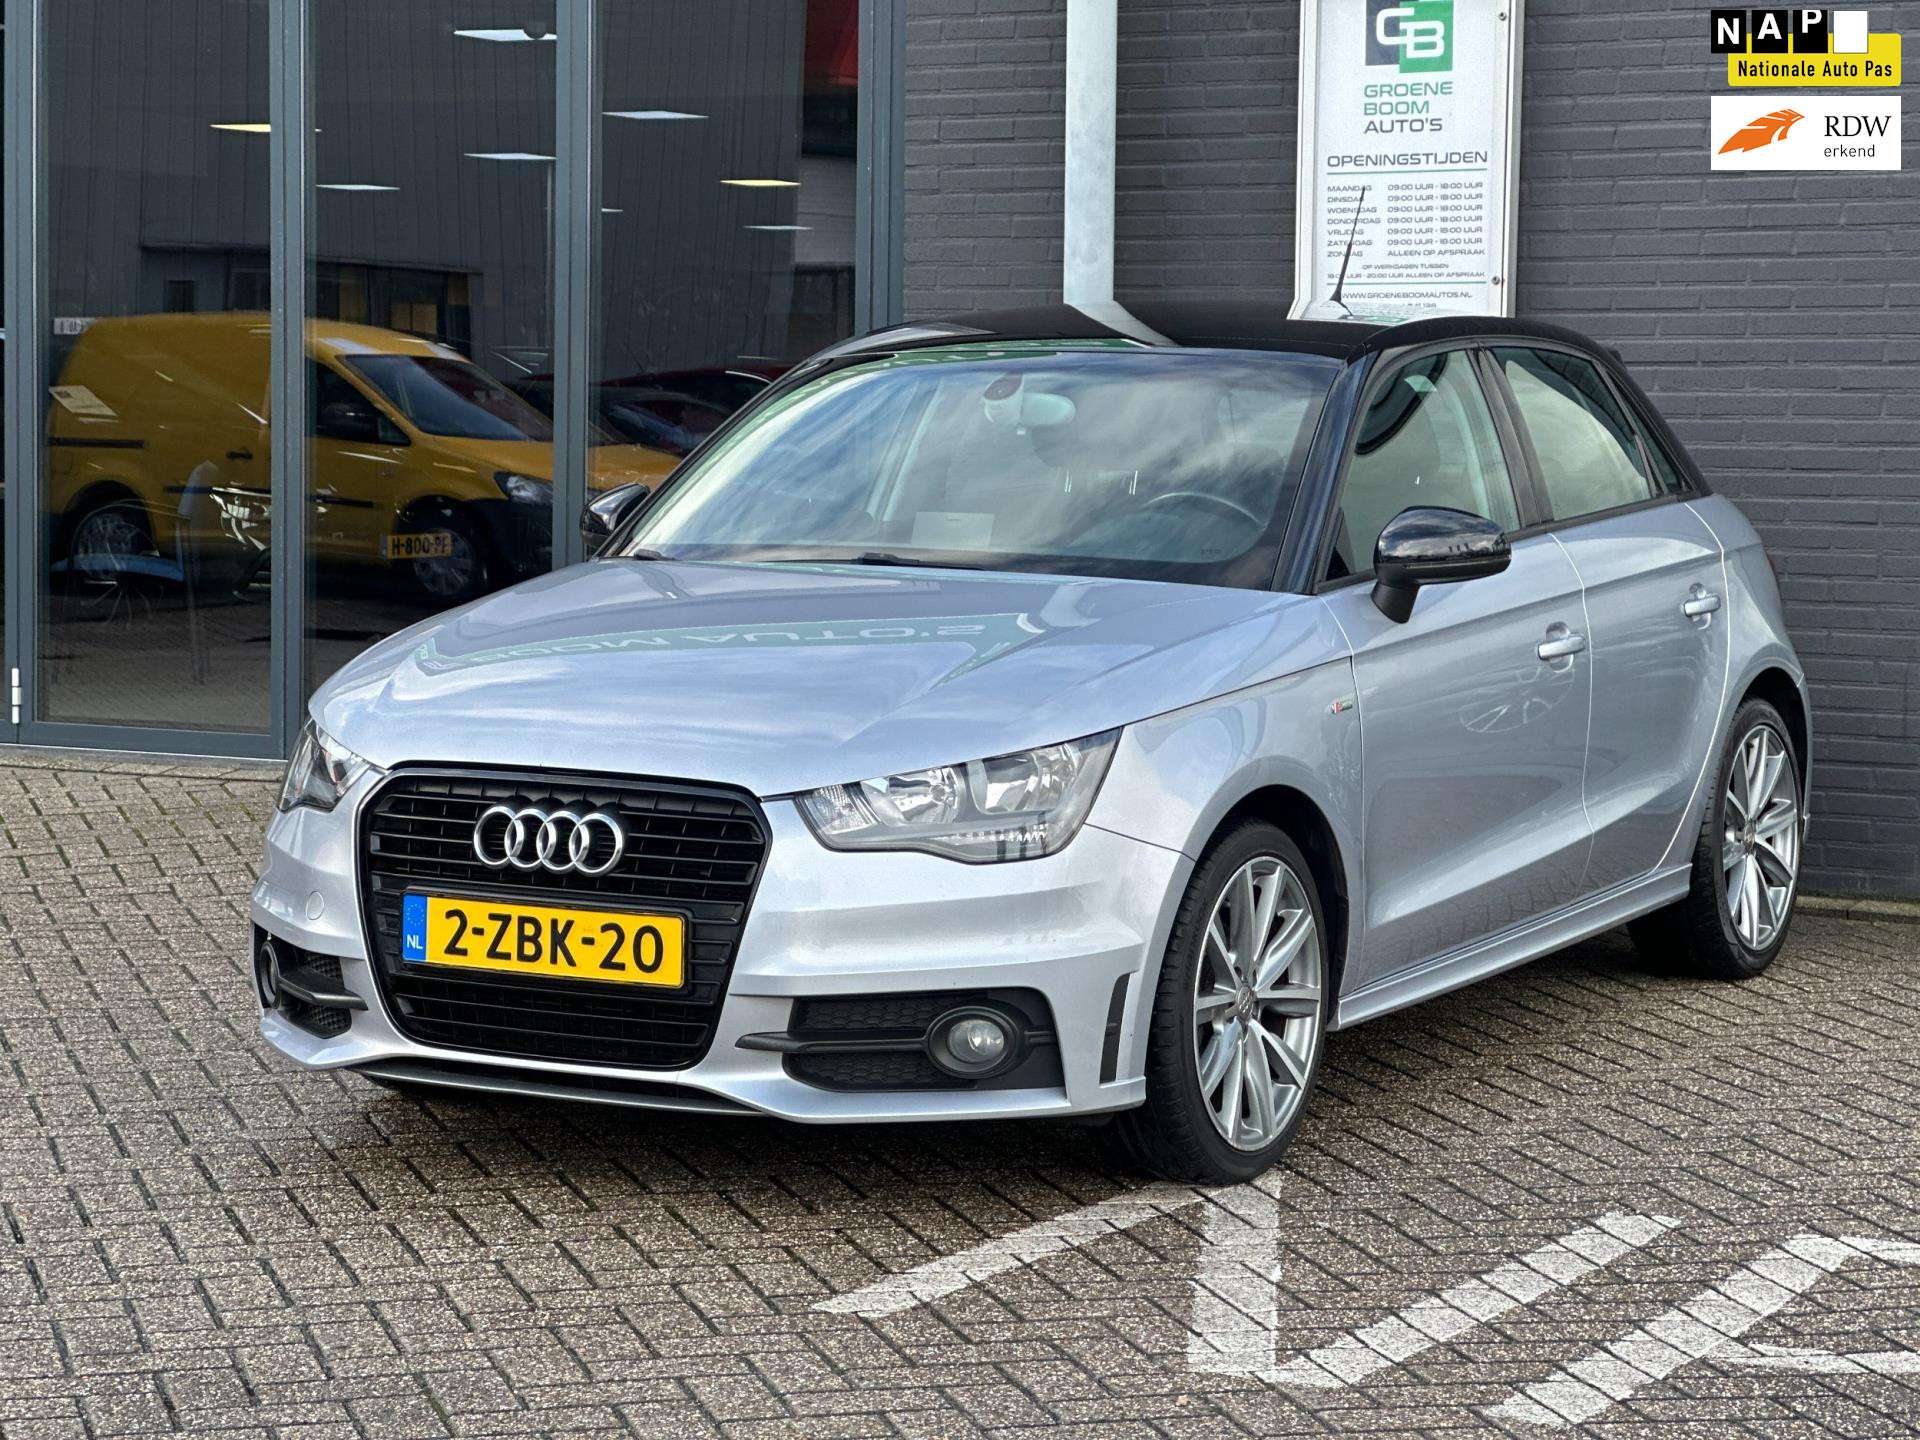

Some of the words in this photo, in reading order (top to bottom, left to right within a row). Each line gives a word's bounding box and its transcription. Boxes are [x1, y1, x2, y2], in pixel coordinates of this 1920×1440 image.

[1363, 81, 1453, 99] GROENE
[1363, 101, 1430, 116] BOOM
[1364, 117, 1443, 134] AUTO'S
[1327, 150, 1488, 168] OPENINGSTIJDEN
[406, 934, 423, 950] NL
[443, 908, 663, 974] 2-ZBK-20
